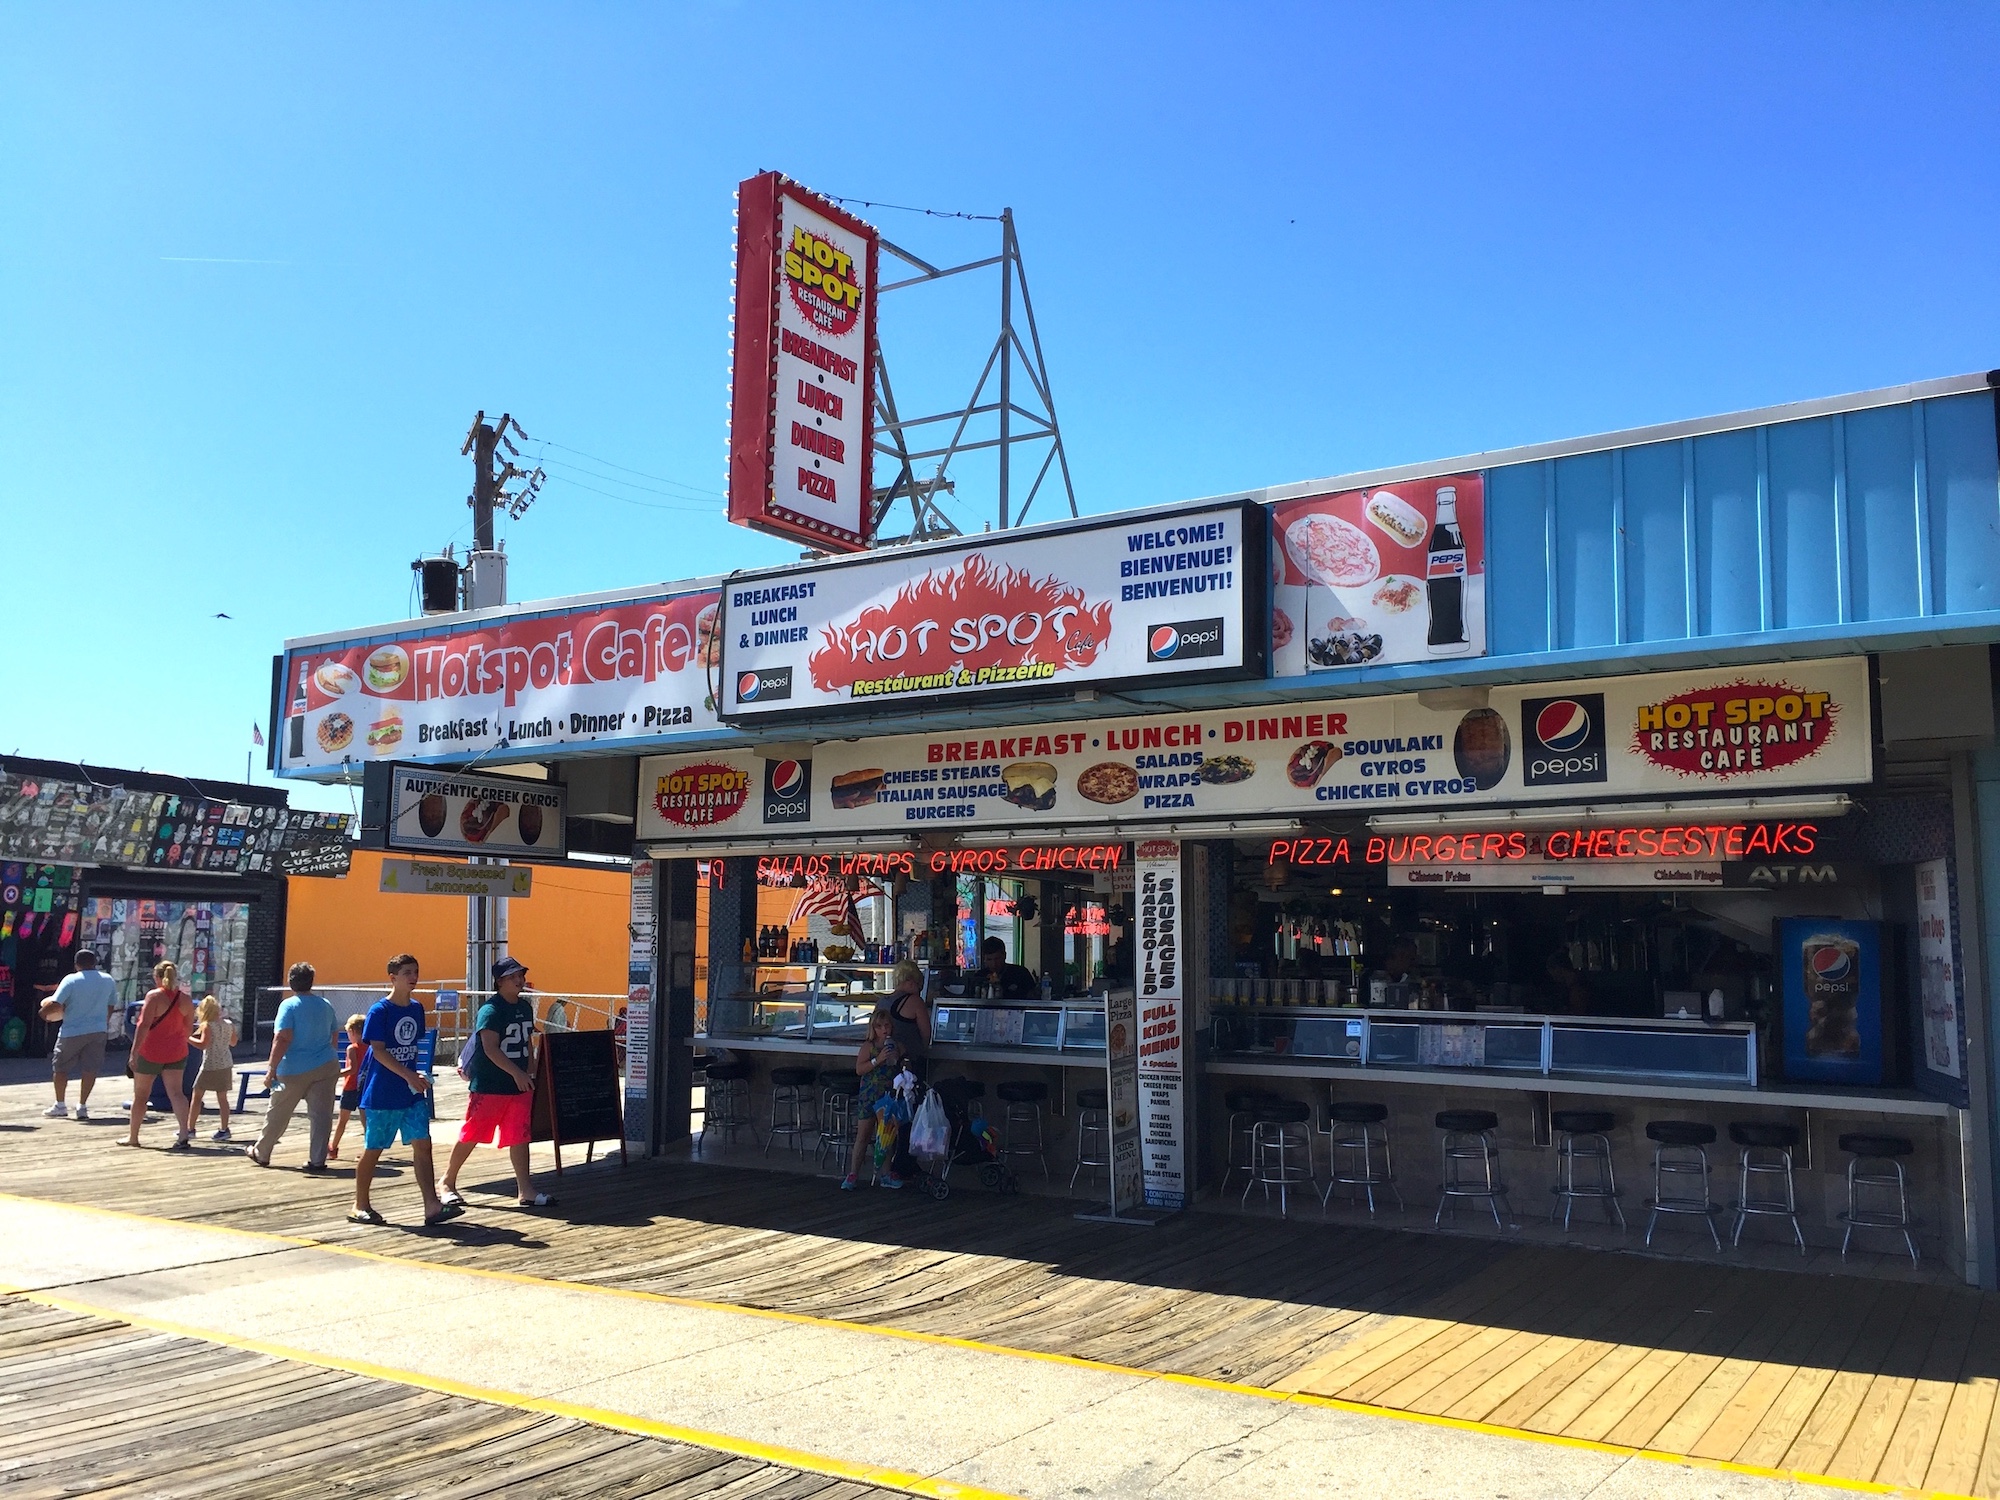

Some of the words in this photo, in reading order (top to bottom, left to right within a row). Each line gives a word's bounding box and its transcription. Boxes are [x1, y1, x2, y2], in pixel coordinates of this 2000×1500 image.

[794, 224, 853, 278] HOT
[785, 250, 862, 310] SPOT
[797, 286, 847, 322] RESTAURANT
[782, 327, 858, 385] BREAKFAST
[797, 379, 843, 421] LUNCH
[791, 420, 845, 465] DINNER
[798, 466, 837, 504] PIZZA
[1127, 522, 1224, 552] WELCOME!
[1120, 546, 1233, 577] BIENVENUE!
[1431, 553, 1464, 564] PEPSI
[734, 582, 816, 608] BREAKFAST
[1121, 571, 1233, 602] BENVENUTI!
[751, 606, 797, 626] LUNCH
[739, 633, 750, 648] &
[754, 626, 808, 647] DINNER
[850, 618, 939, 664] HOT
[950, 605, 1079, 654] SPOT
[1181, 625, 1218, 647] pepsi
[413, 631, 573, 707] Hotspot
[582, 613, 696, 684] Cafe
[760, 674, 788, 692] pepsi
[852, 670, 954, 698] Restaurant
[958, 669, 972, 686] &
[977, 662, 1056, 685] Pizzeria
[1638, 701, 1719, 730] HOT
[1725, 691, 1831, 725] SPOT
[419, 717, 488, 743] Breakfast
[509, 709, 552, 741] Lunch
[570, 710, 625, 735] Dinner
[644, 705, 692, 727] Pizza
[927, 733, 1087, 763] BREAKFAST
[1107, 724, 1202, 750] LUNCH
[1224, 713, 1348, 743] DINNER
[1343, 734, 1443, 757] SOUVLAKI
[1650, 721, 1815, 752] RESTAURANT
[1135, 751, 1203, 769] SALADS
[1360, 758, 1426, 776] GYROS
[1531, 753, 1599, 778] pepsi
[1700, 744, 1763, 770] CAFÉ
[657, 775, 695, 794] HOT
[698, 771, 748, 791] SPOT
[883, 768, 938, 784] CHEESE
[941, 764, 1001, 781] STEAKS
[1138, 772, 1201, 789] WRAPS
[405, 778, 478, 799] AUTHENTIC
[478, 784, 520, 803] GREEK
[522, 790, 559, 808] GYROS
[661, 791, 739, 809] RESTAURANT
[876, 787, 935, 803] ITALIAN
[938, 783, 1007, 800] SAUSAGE
[1315, 782, 1400, 801] CHICKEN
[1405, 777, 1477, 796] GYROS
[767, 800, 807, 819] pepsi
[906, 804, 976, 820] BURGERS
[1144, 793, 1195, 809] PIZZA
[683, 804, 714, 823] CAFÉ
[290, 849, 311, 858] WE
[320, 845, 342, 854] DO
[1269, 838, 1351, 865] PIZZA
[1365, 832, 1527, 864] BURGERS
[1549, 824, 1818, 858] CHEESESTEAKS
[282, 851, 347, 867] CUSTOM
[757, 854, 832, 879] SALADS
[839, 852, 915, 875] WRAPS
[930, 848, 1007, 873] GYROS
[1019, 845, 1123, 870] CHICKEN
[410, 863, 443, 877] Fresh
[446, 865, 507, 881] Squeezed
[1748, 864, 1838, 883] ATM
[425, 879, 489, 894] Lemonade
[1141, 872, 1158, 996] CHARBROILED
[1157, 878, 1176, 989] SAUSAGES
[1815, 982, 1849, 994] pepsi
[1110, 998, 1132, 1010] Large
[1143, 1004, 1176, 1023] FULL
[1110, 1010, 1132, 1021] Pizza
[500, 1021, 532, 1058] 25
[1143, 1020, 1176, 1039] KIDS
[1140, 1036, 1180, 1057] MENU
[1115, 1149, 1137, 1162] MENU
[1116, 1140, 1134, 1153] KIDS
[1162, 1171, 1181, 1179] STEAKS
